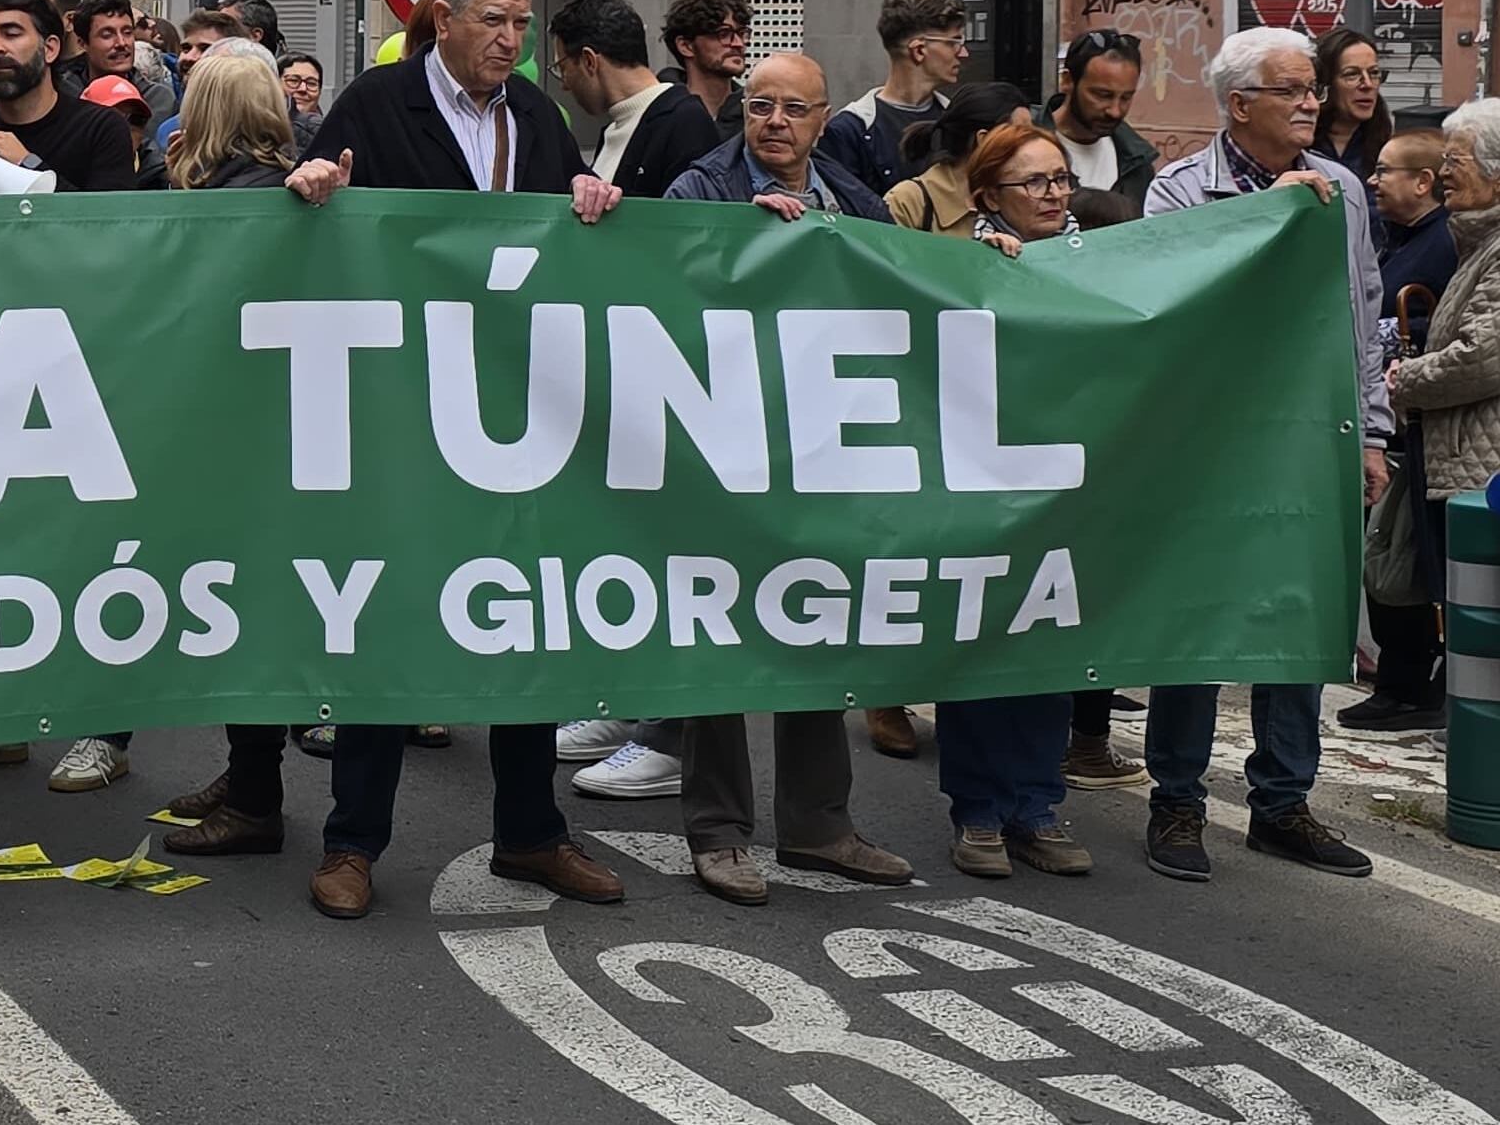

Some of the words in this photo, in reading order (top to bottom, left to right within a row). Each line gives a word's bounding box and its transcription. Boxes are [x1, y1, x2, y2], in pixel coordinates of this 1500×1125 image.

[240, 246, 1086, 493] TÚNEL
[291, 557, 386, 655] Y
[439, 547, 1082, 655] GIORGETA
